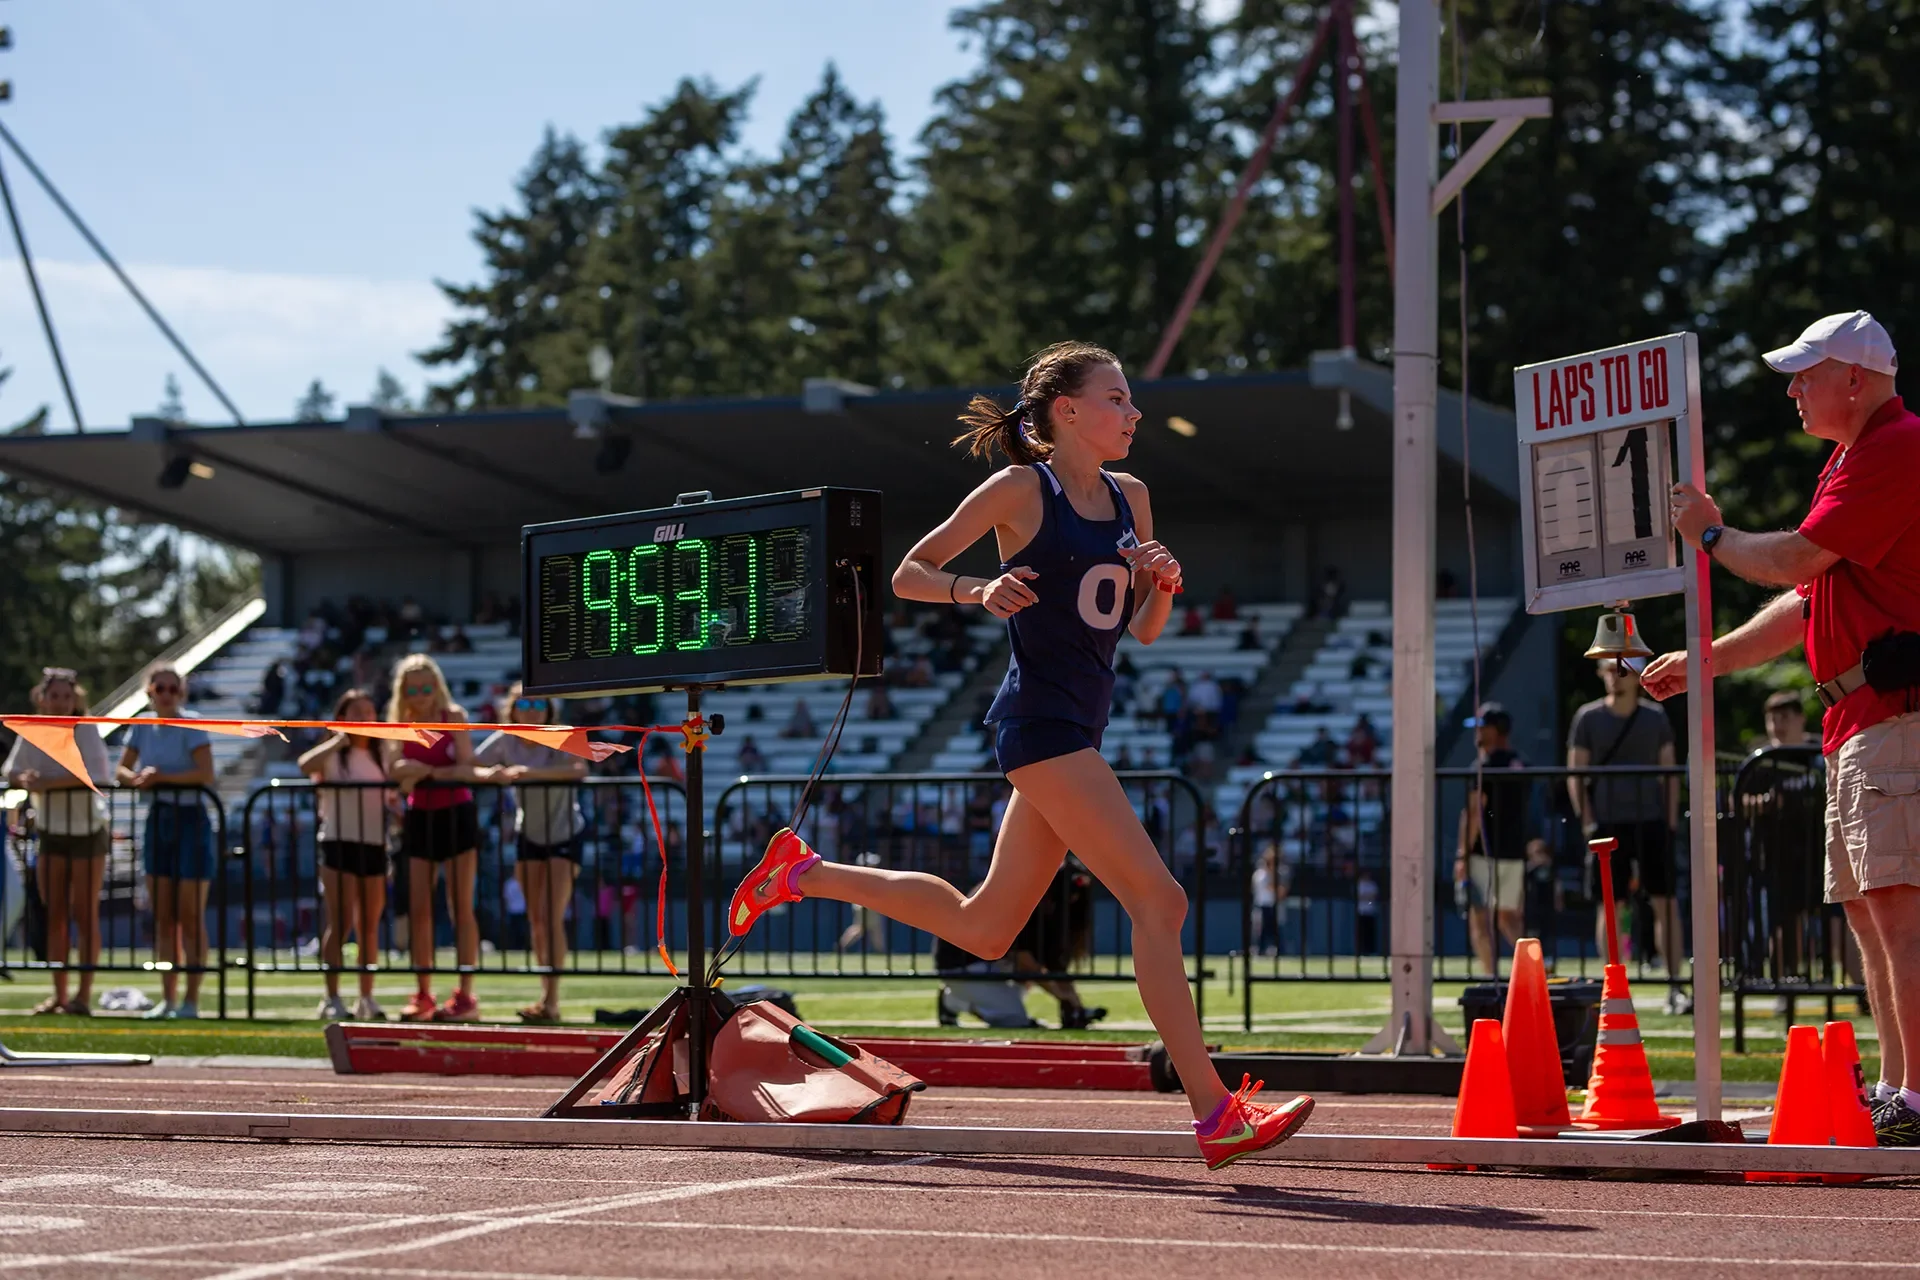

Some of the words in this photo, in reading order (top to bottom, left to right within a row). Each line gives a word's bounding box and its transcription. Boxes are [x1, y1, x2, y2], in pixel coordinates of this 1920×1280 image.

[1533, 361, 1596, 431] LAPS
[1600, 354, 1632, 418] TO
[1638, 346, 1669, 411] GO
[1611, 427, 1653, 539] 1
[653, 523, 685, 543] GILL
[583, 539, 756, 655] 9:53.1
[1077, 563, 1130, 630] O
